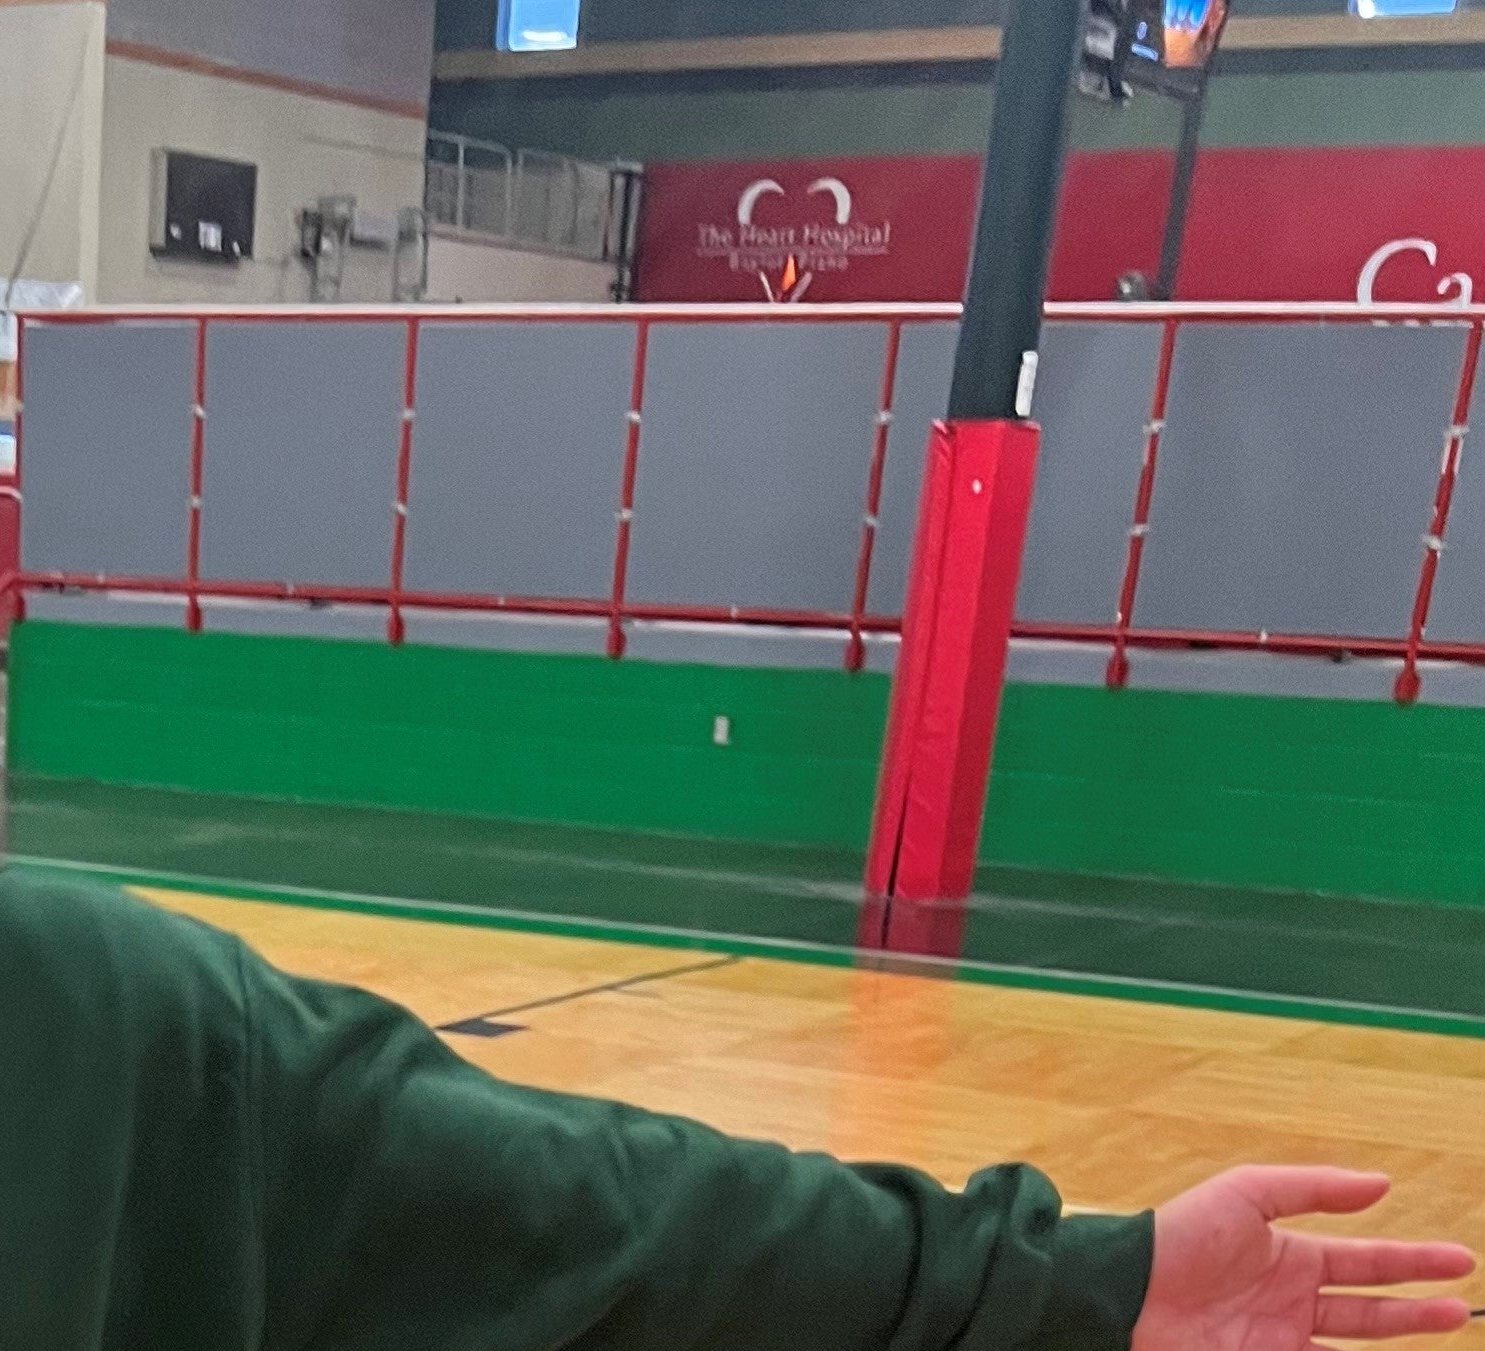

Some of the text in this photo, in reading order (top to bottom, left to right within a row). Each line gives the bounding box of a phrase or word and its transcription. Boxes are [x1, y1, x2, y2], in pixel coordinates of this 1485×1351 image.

[698, 220, 892, 250] The Heart Hospital
